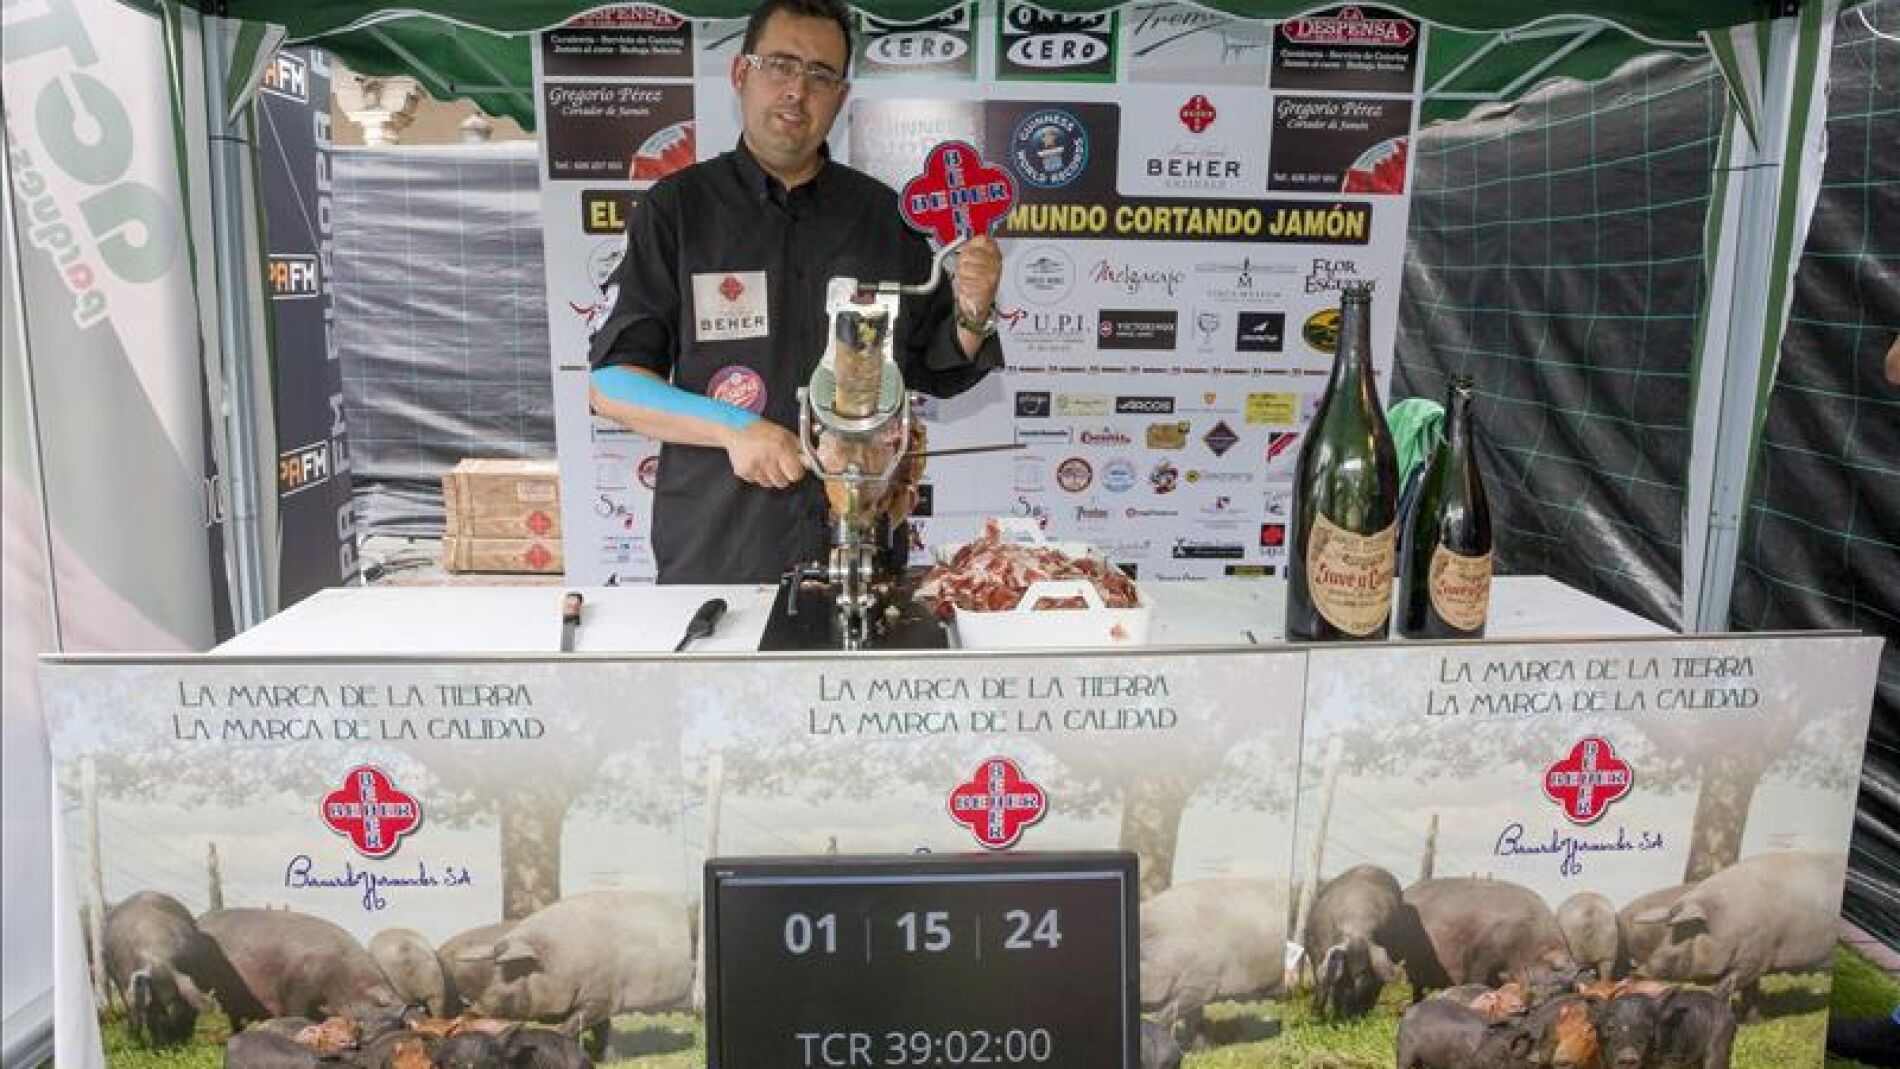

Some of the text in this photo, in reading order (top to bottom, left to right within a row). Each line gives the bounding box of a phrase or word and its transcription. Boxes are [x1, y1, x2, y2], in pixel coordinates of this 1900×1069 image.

[880, 37, 955, 58] CERO
[1021, 39, 1096, 59] CERO
[550, 86, 663, 107] Gregorio Pérez
[1277, 100, 1383, 120] Gregorio Pérez
[1146, 158, 1241, 178] BEHER
[911, 183, 1006, 214] BEHER
[590, 200, 1365, 238] EL MUNDO CORTANDO JAMÓN
[700, 315, 765, 333] BEHER
[1440, 657, 1754, 684] LA MARCA DE LA TIERRA
[179, 681, 533, 708] LA MARCA DE LA TIERRA
[819, 674, 1170, 701] LA MARCA DE LA TIERRA
[1426, 688, 1759, 716] LA MARCA DE LA CALIDAD
[173, 714, 546, 740] LA MARCA DE LA CALIDAD
[809, 708, 1177, 735] LA MARCA DE LA CALIDAD
[785, 909, 1062, 954] 01 15 24
[797, 1028, 1052, 1068] TCR 39:02:00
